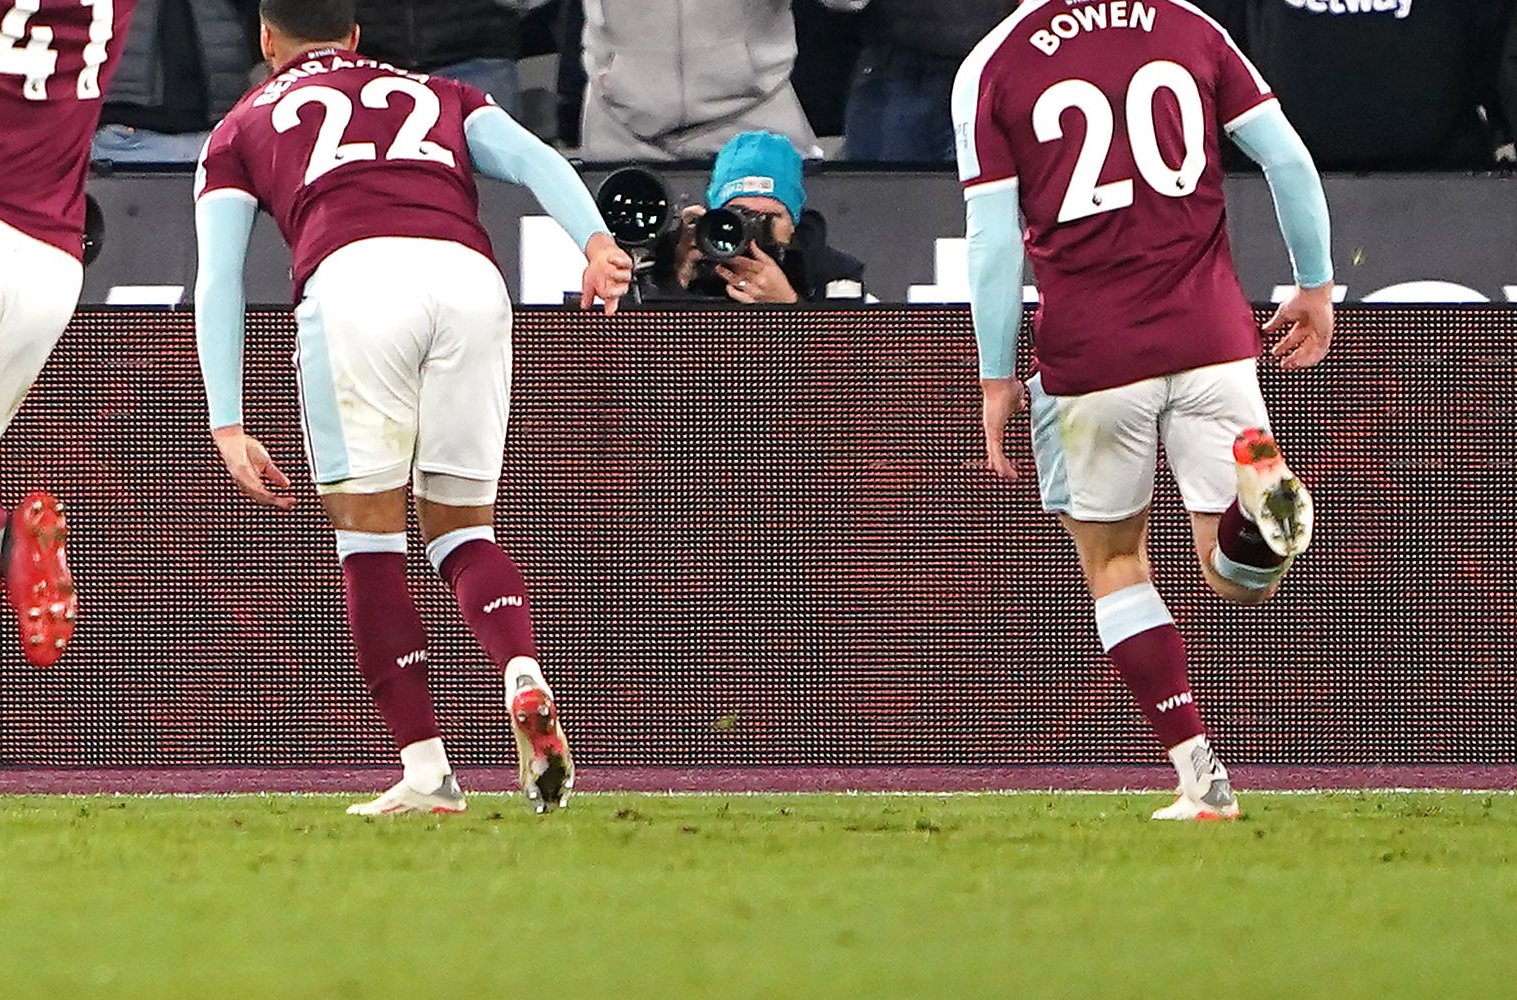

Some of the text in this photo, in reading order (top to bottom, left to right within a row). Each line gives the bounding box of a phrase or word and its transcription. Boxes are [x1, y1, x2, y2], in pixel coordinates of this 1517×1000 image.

[1029, 0, 1157, 56] BOWEN
[271, 76, 456, 186] 22
[1032, 59, 1209, 223] 20
[482, 595, 523, 613] WHU
